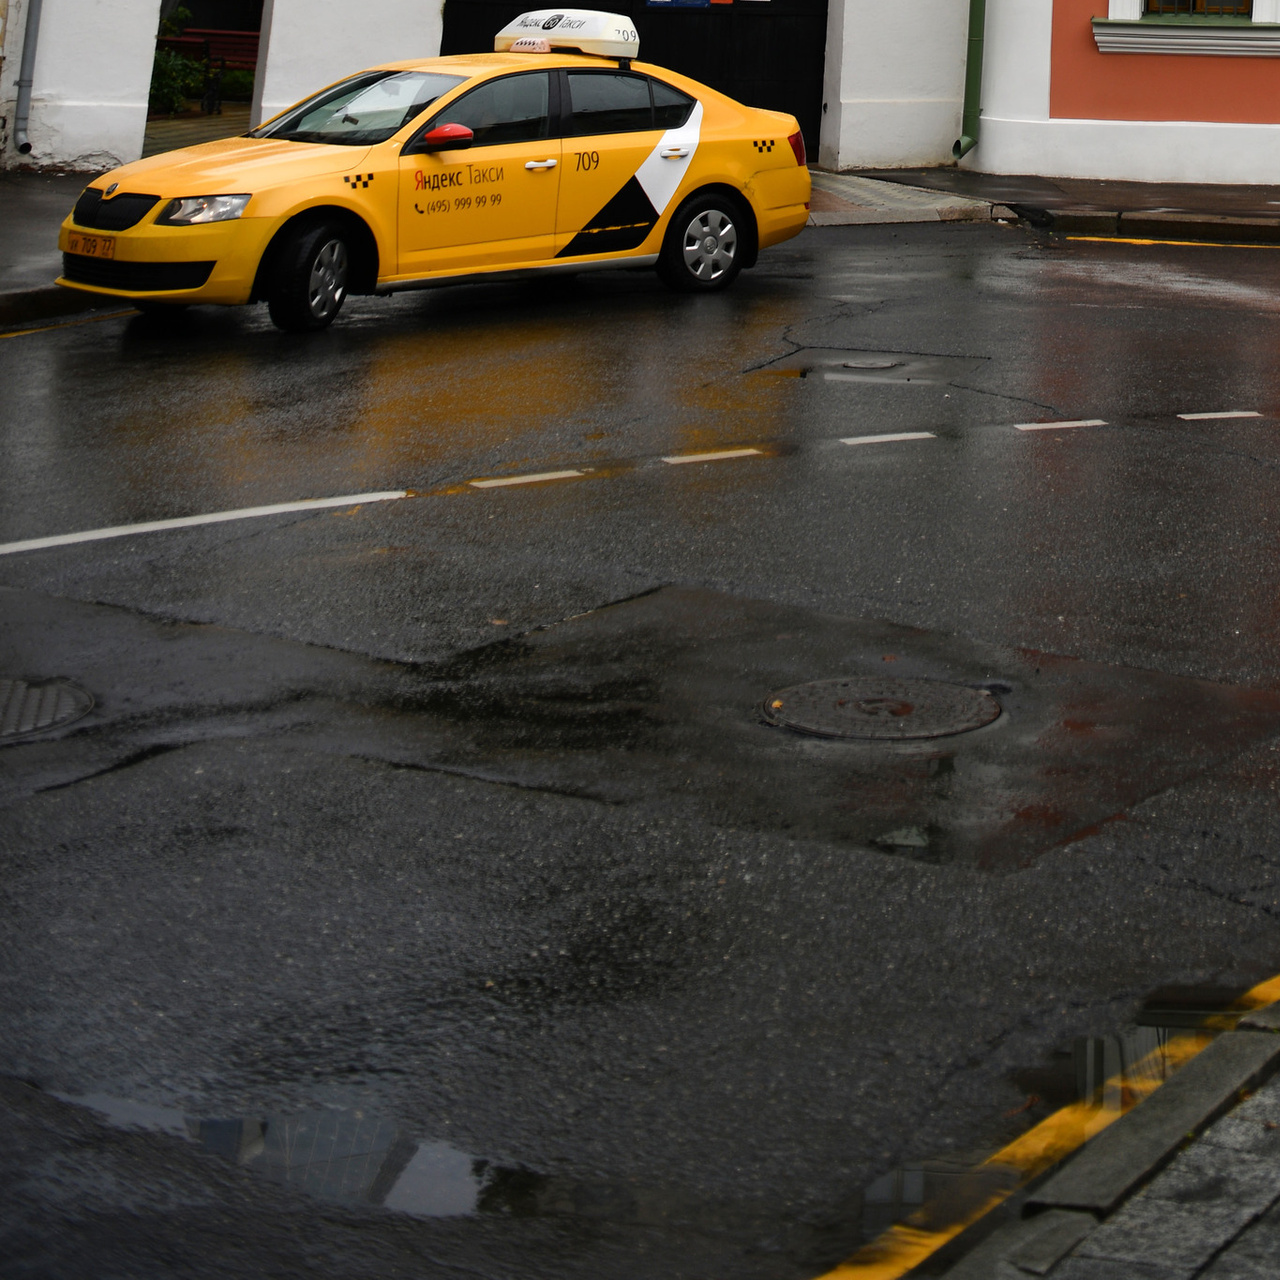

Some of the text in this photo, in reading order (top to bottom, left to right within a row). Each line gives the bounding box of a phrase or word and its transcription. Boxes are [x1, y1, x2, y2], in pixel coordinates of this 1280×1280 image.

[559, 16, 587, 29] Такси
[574, 151, 600, 172] 709
[415, 164, 505, 191] Яндекс Такси
[426, 194, 502, 215] (495) 999 99 99
